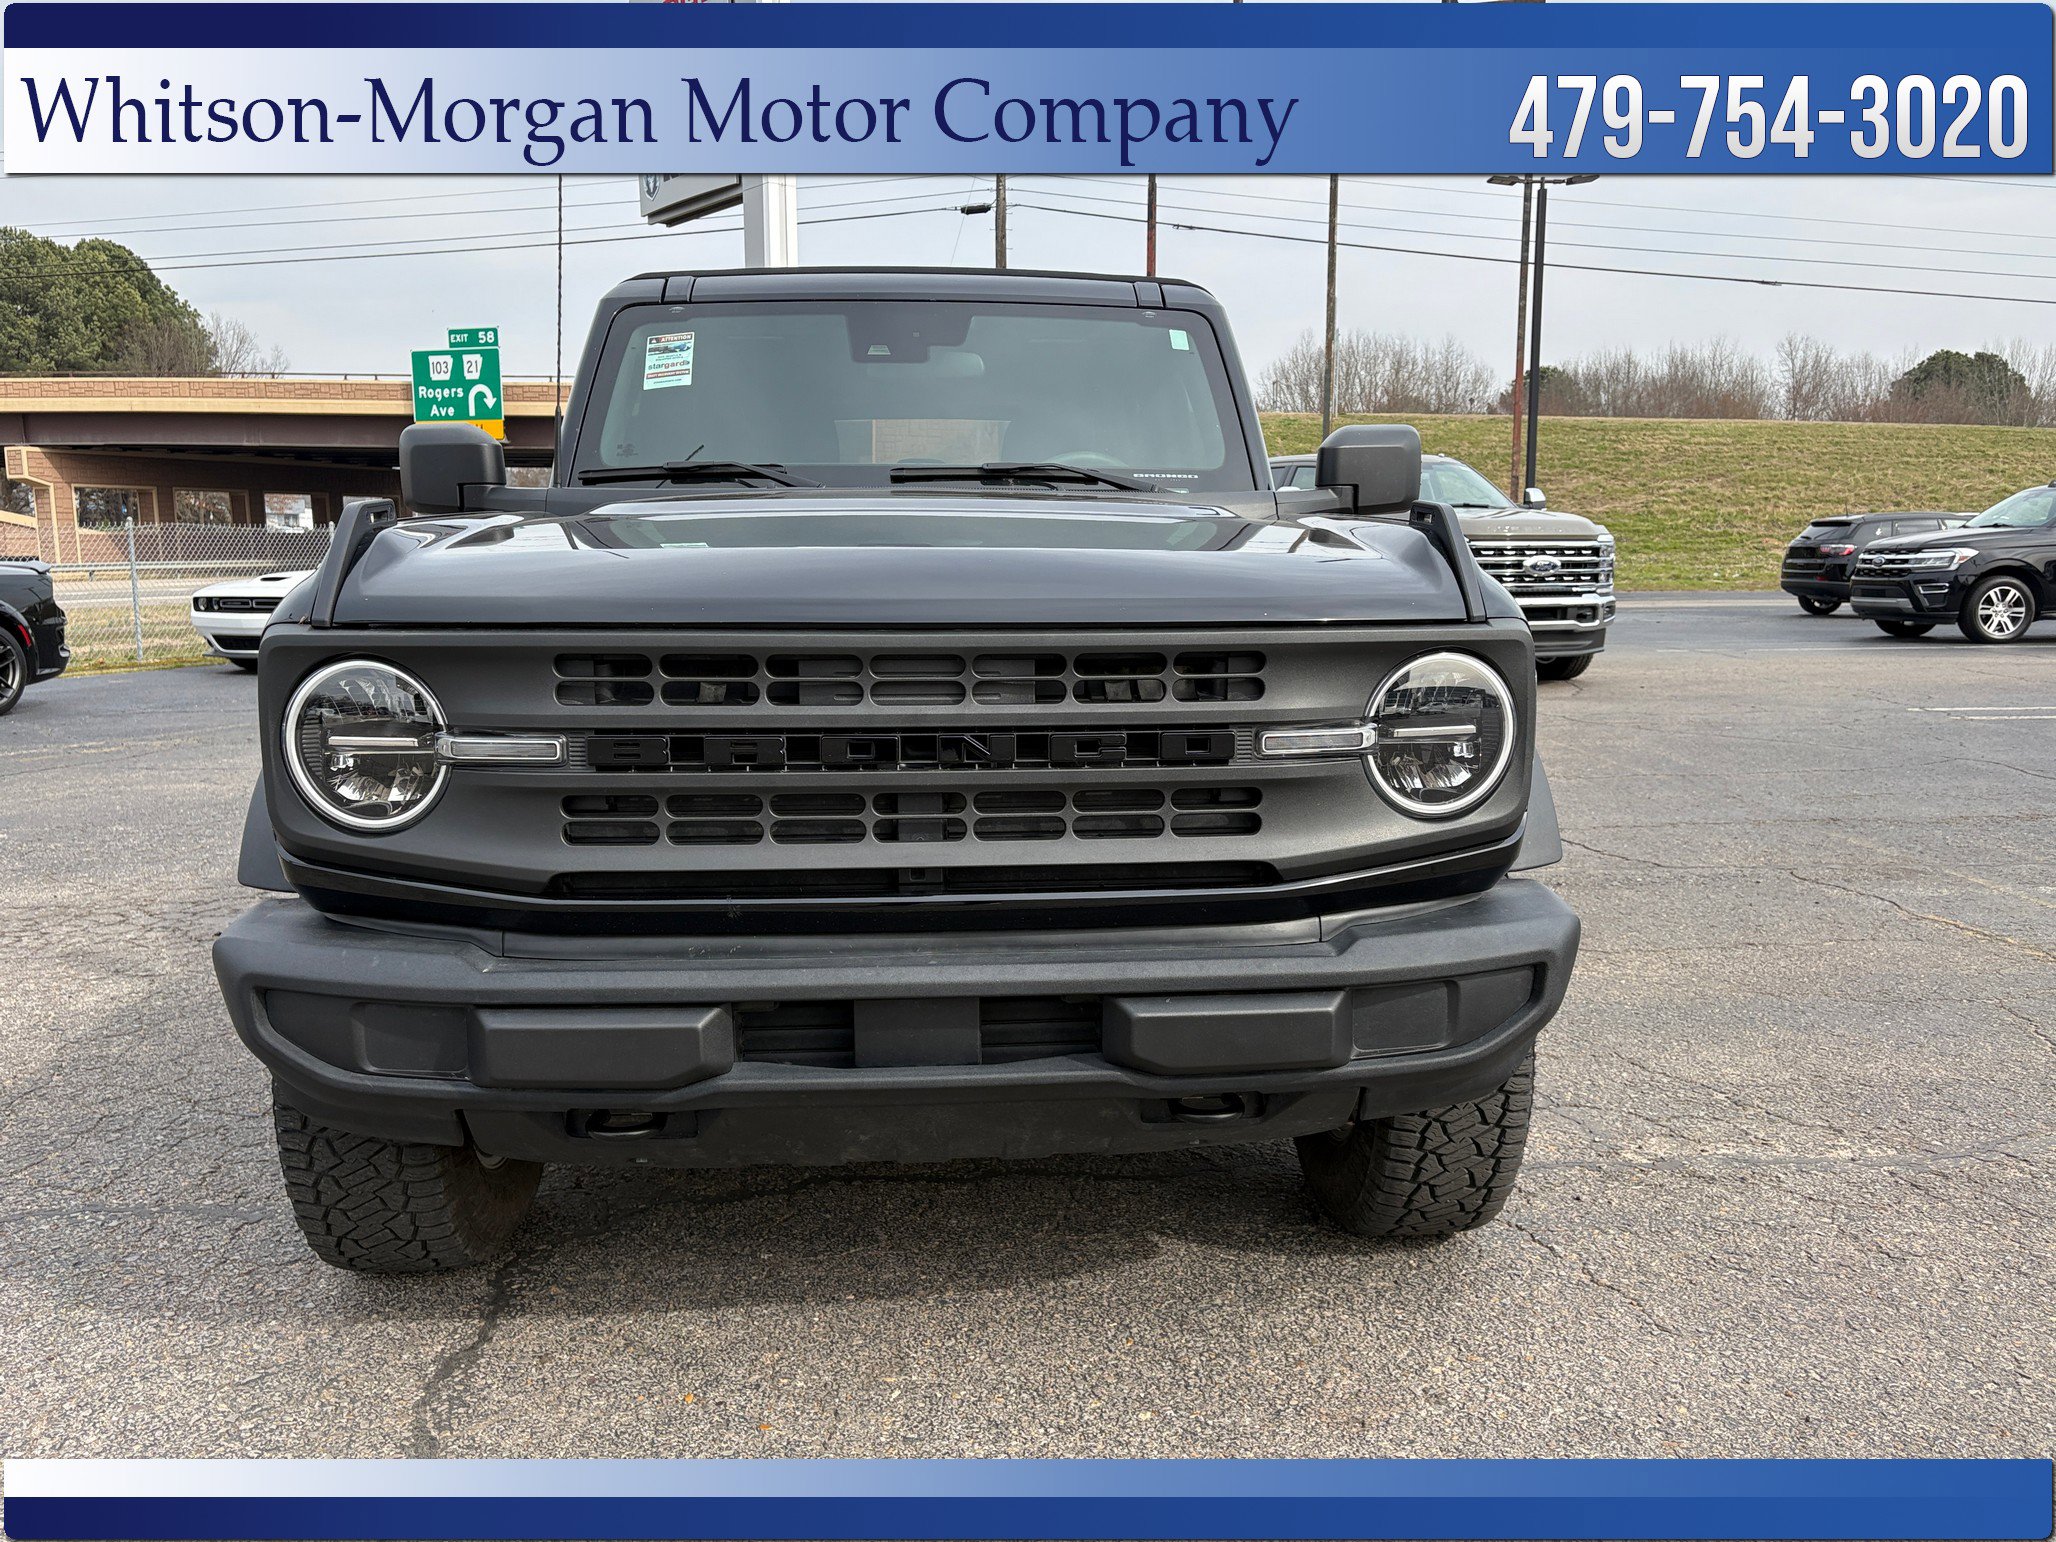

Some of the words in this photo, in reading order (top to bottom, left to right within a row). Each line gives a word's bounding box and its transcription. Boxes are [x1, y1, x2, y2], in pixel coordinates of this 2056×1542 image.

[450, 333, 469, 343] EXIT
[478, 331, 495, 344] 58
[661, 334, 692, 343] ATTENTION
[431, 361, 449, 375] 103
[466, 360, 479, 374] 21
[648, 360, 685, 370] stargard
[418, 386, 464, 401] Rogers
[430, 404, 455, 417] Ave
[587, 732, 1236, 766] BRONCO
